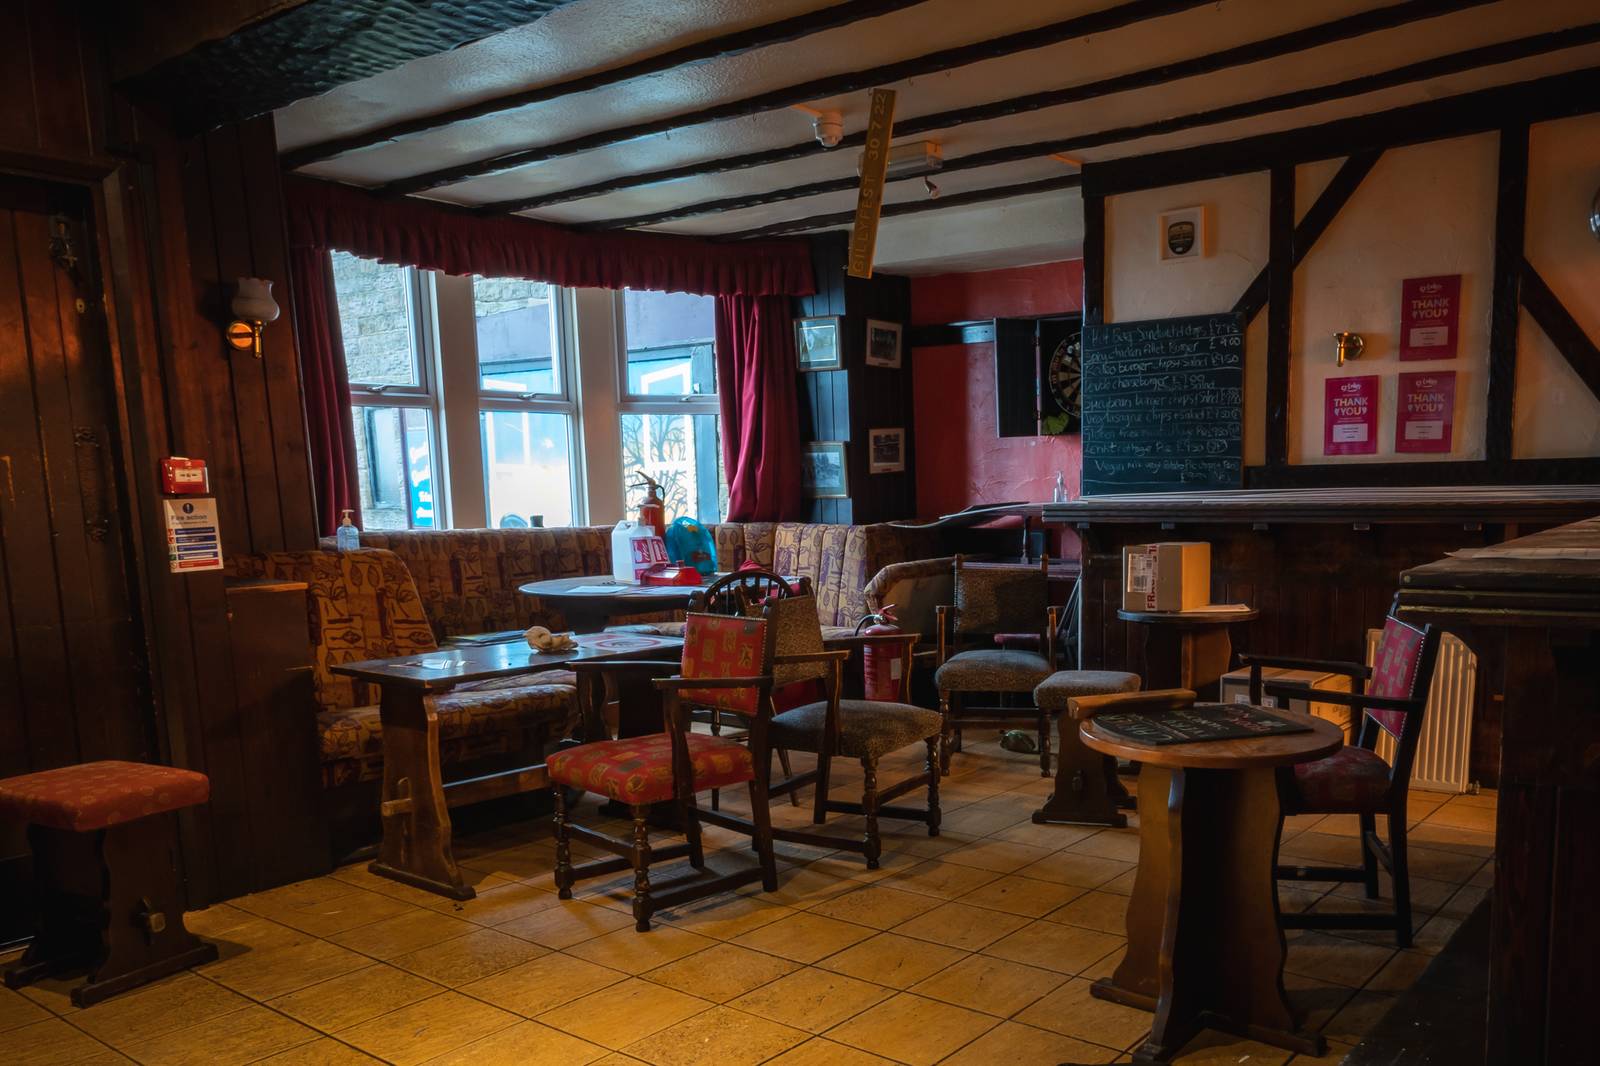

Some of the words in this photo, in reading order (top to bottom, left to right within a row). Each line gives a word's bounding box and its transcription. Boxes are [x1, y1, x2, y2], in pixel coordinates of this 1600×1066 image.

[874, 93, 888, 115] 22
[871, 121, 882, 131] 7
[868, 138, 881, 161] 30
[852, 177, 876, 272] GILLYFEST
[1412, 298, 1449, 310] THANK
[1419, 309, 1442, 319] YOU
[1334, 397, 1368, 407] THANK
[1408, 393, 1445, 403] THANK
[1341, 406, 1362, 416] YOU
[1414, 403, 1436, 413] YOU
